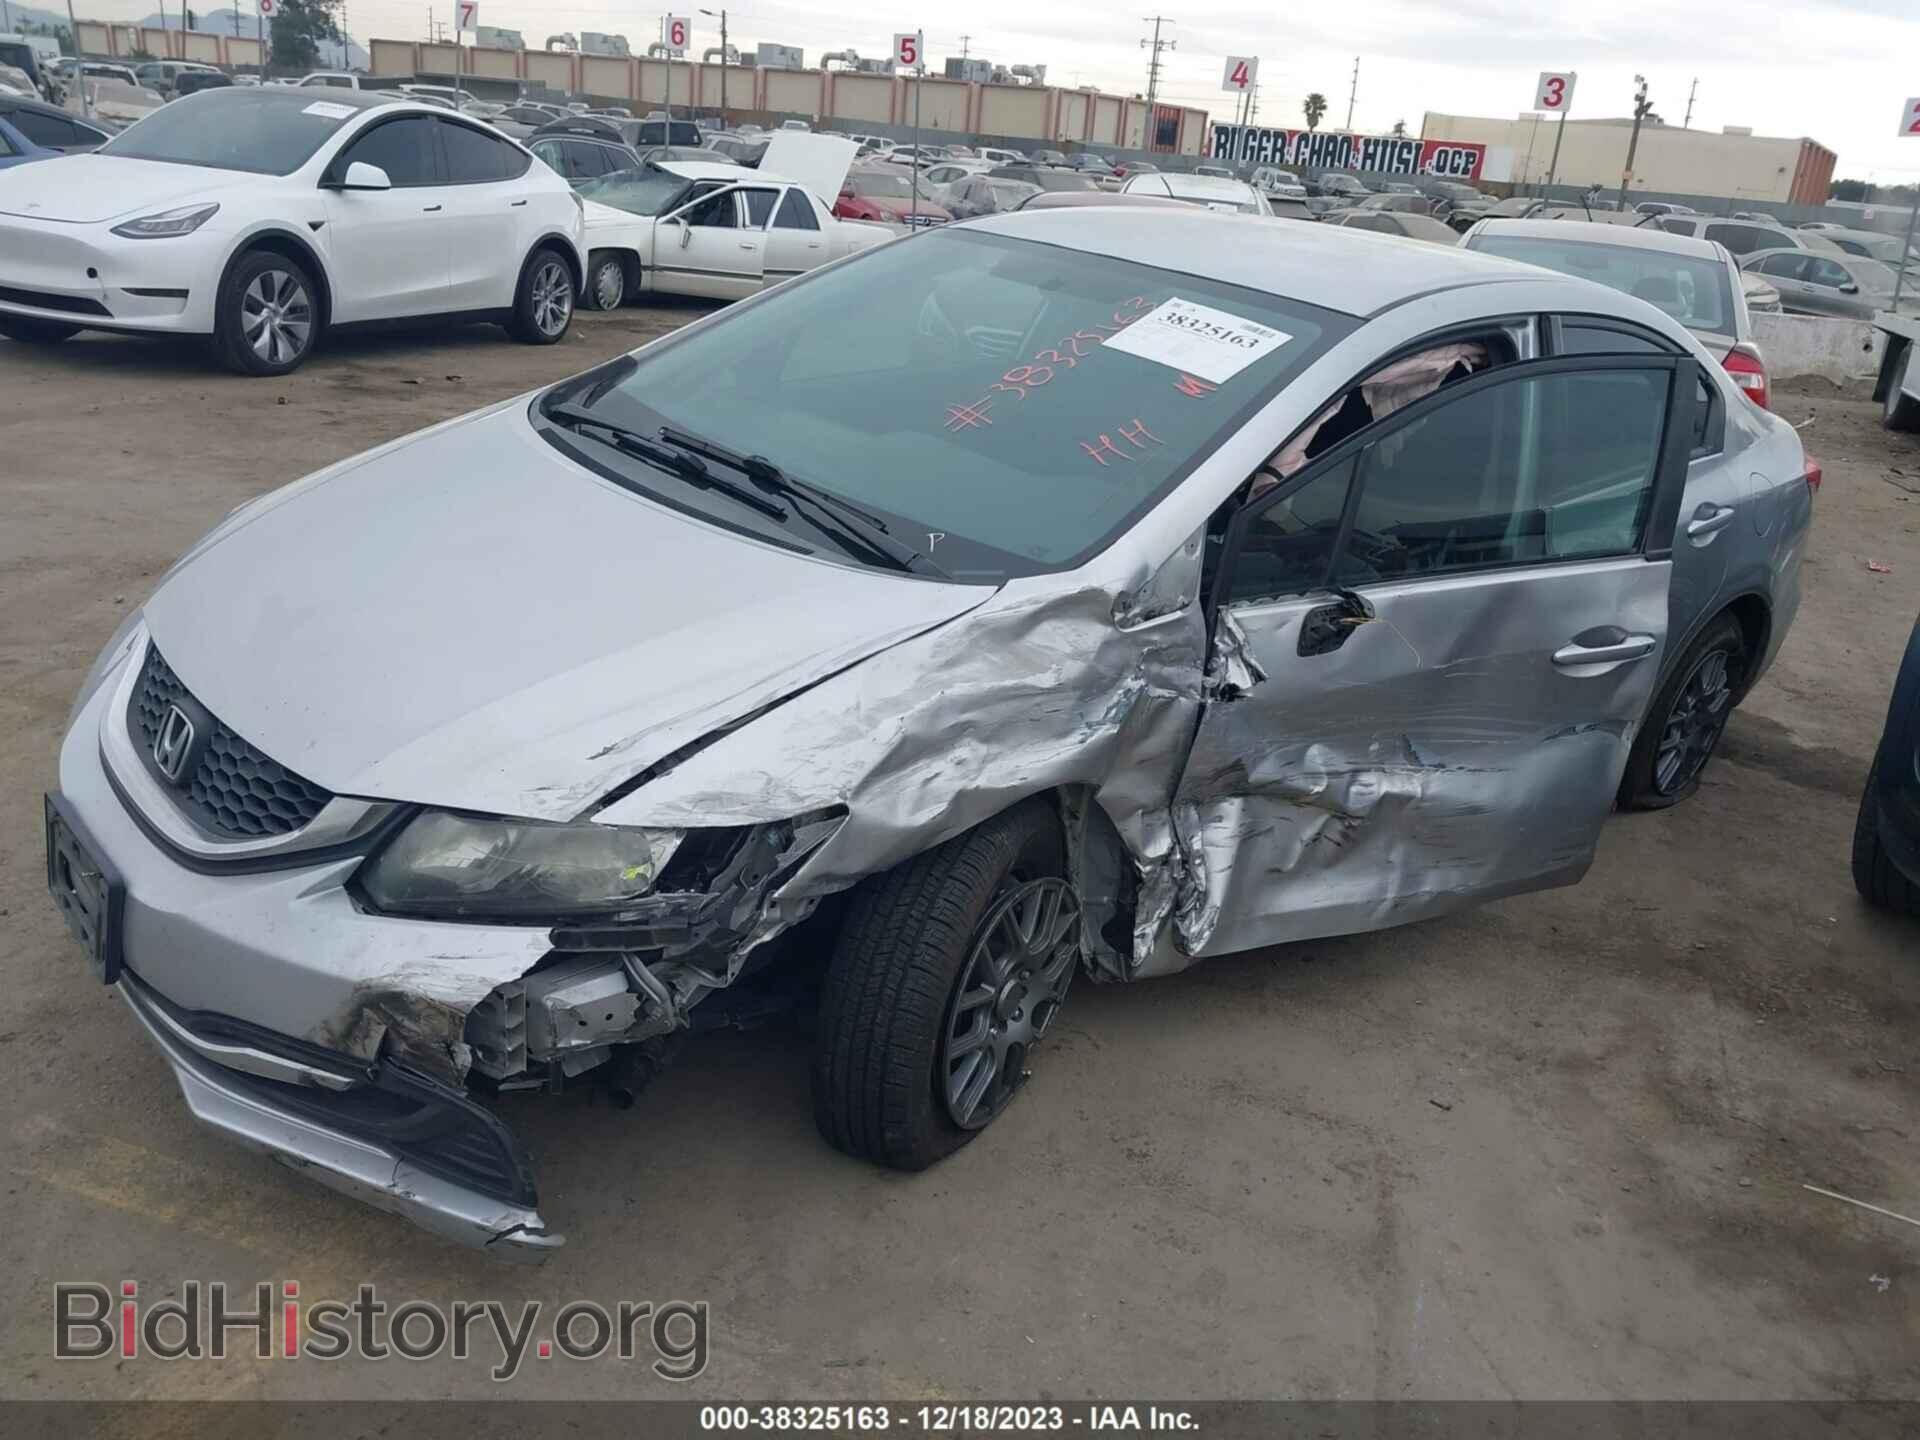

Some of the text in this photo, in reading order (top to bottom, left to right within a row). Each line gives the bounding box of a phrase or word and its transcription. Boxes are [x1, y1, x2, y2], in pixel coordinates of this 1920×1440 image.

[460, 4, 473, 28] 7
[671, 21, 685, 46] 6
[900, 37, 917, 65] 5
[1230, 61, 1249, 89] 4
[1543, 77, 1566, 107] 3
[1437, 149, 1477, 175] OCP
[1158, 312, 1260, 349] 38325163
